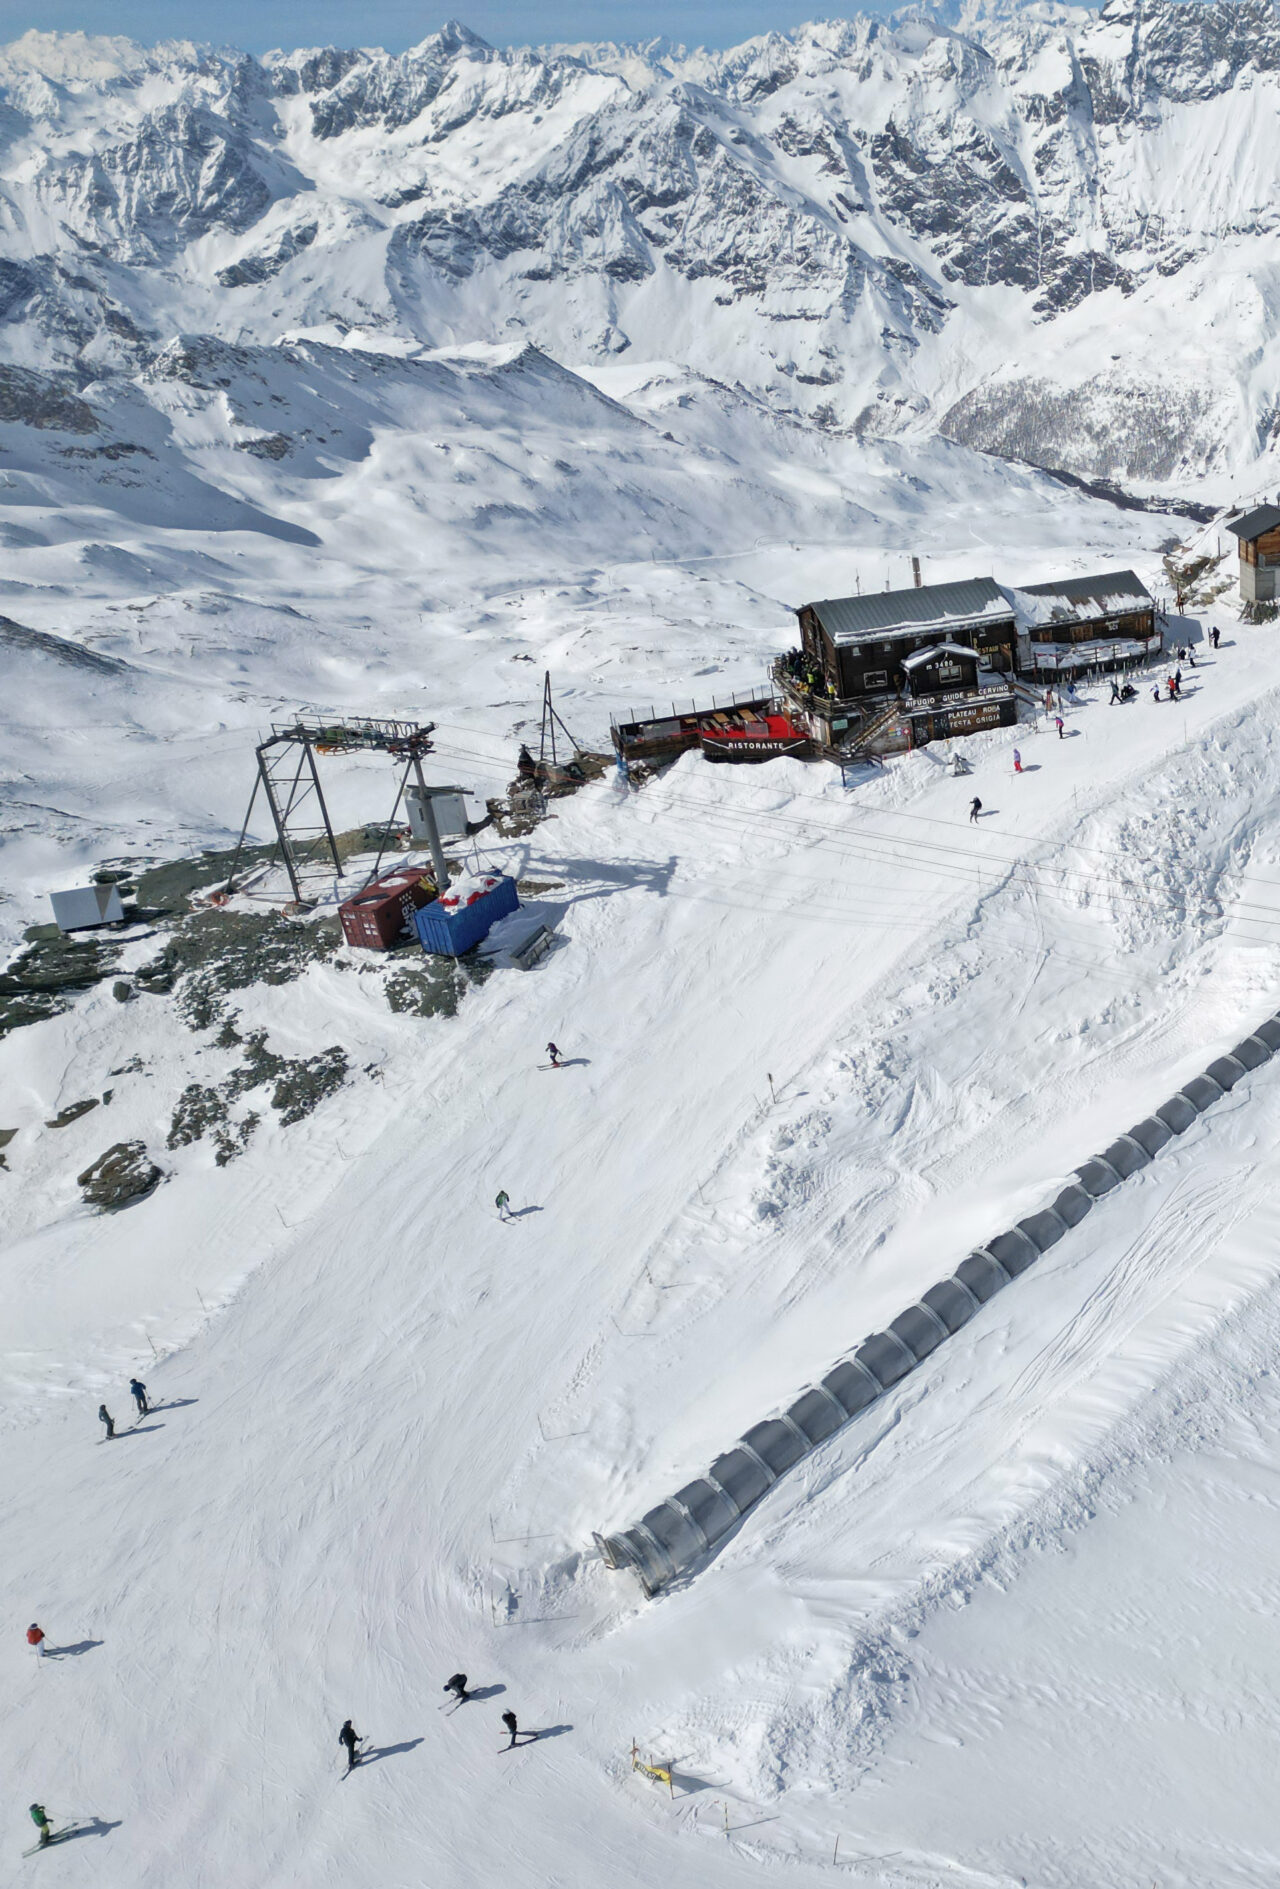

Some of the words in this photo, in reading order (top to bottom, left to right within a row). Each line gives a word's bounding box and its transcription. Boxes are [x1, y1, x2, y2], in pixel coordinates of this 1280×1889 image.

[975, 642, 1011, 654] ESTAURNT
[905, 698, 935, 708] RIFUGIO
[942, 692, 964, 702] GUIDE
[978, 684, 1009, 696] CERVINO
[948, 708, 977, 719] PLATEAU
[949, 719, 972, 729] TESTA
[976, 714, 1001, 724] GRIGIA
[728, 742, 784, 750] RISTORANTE
